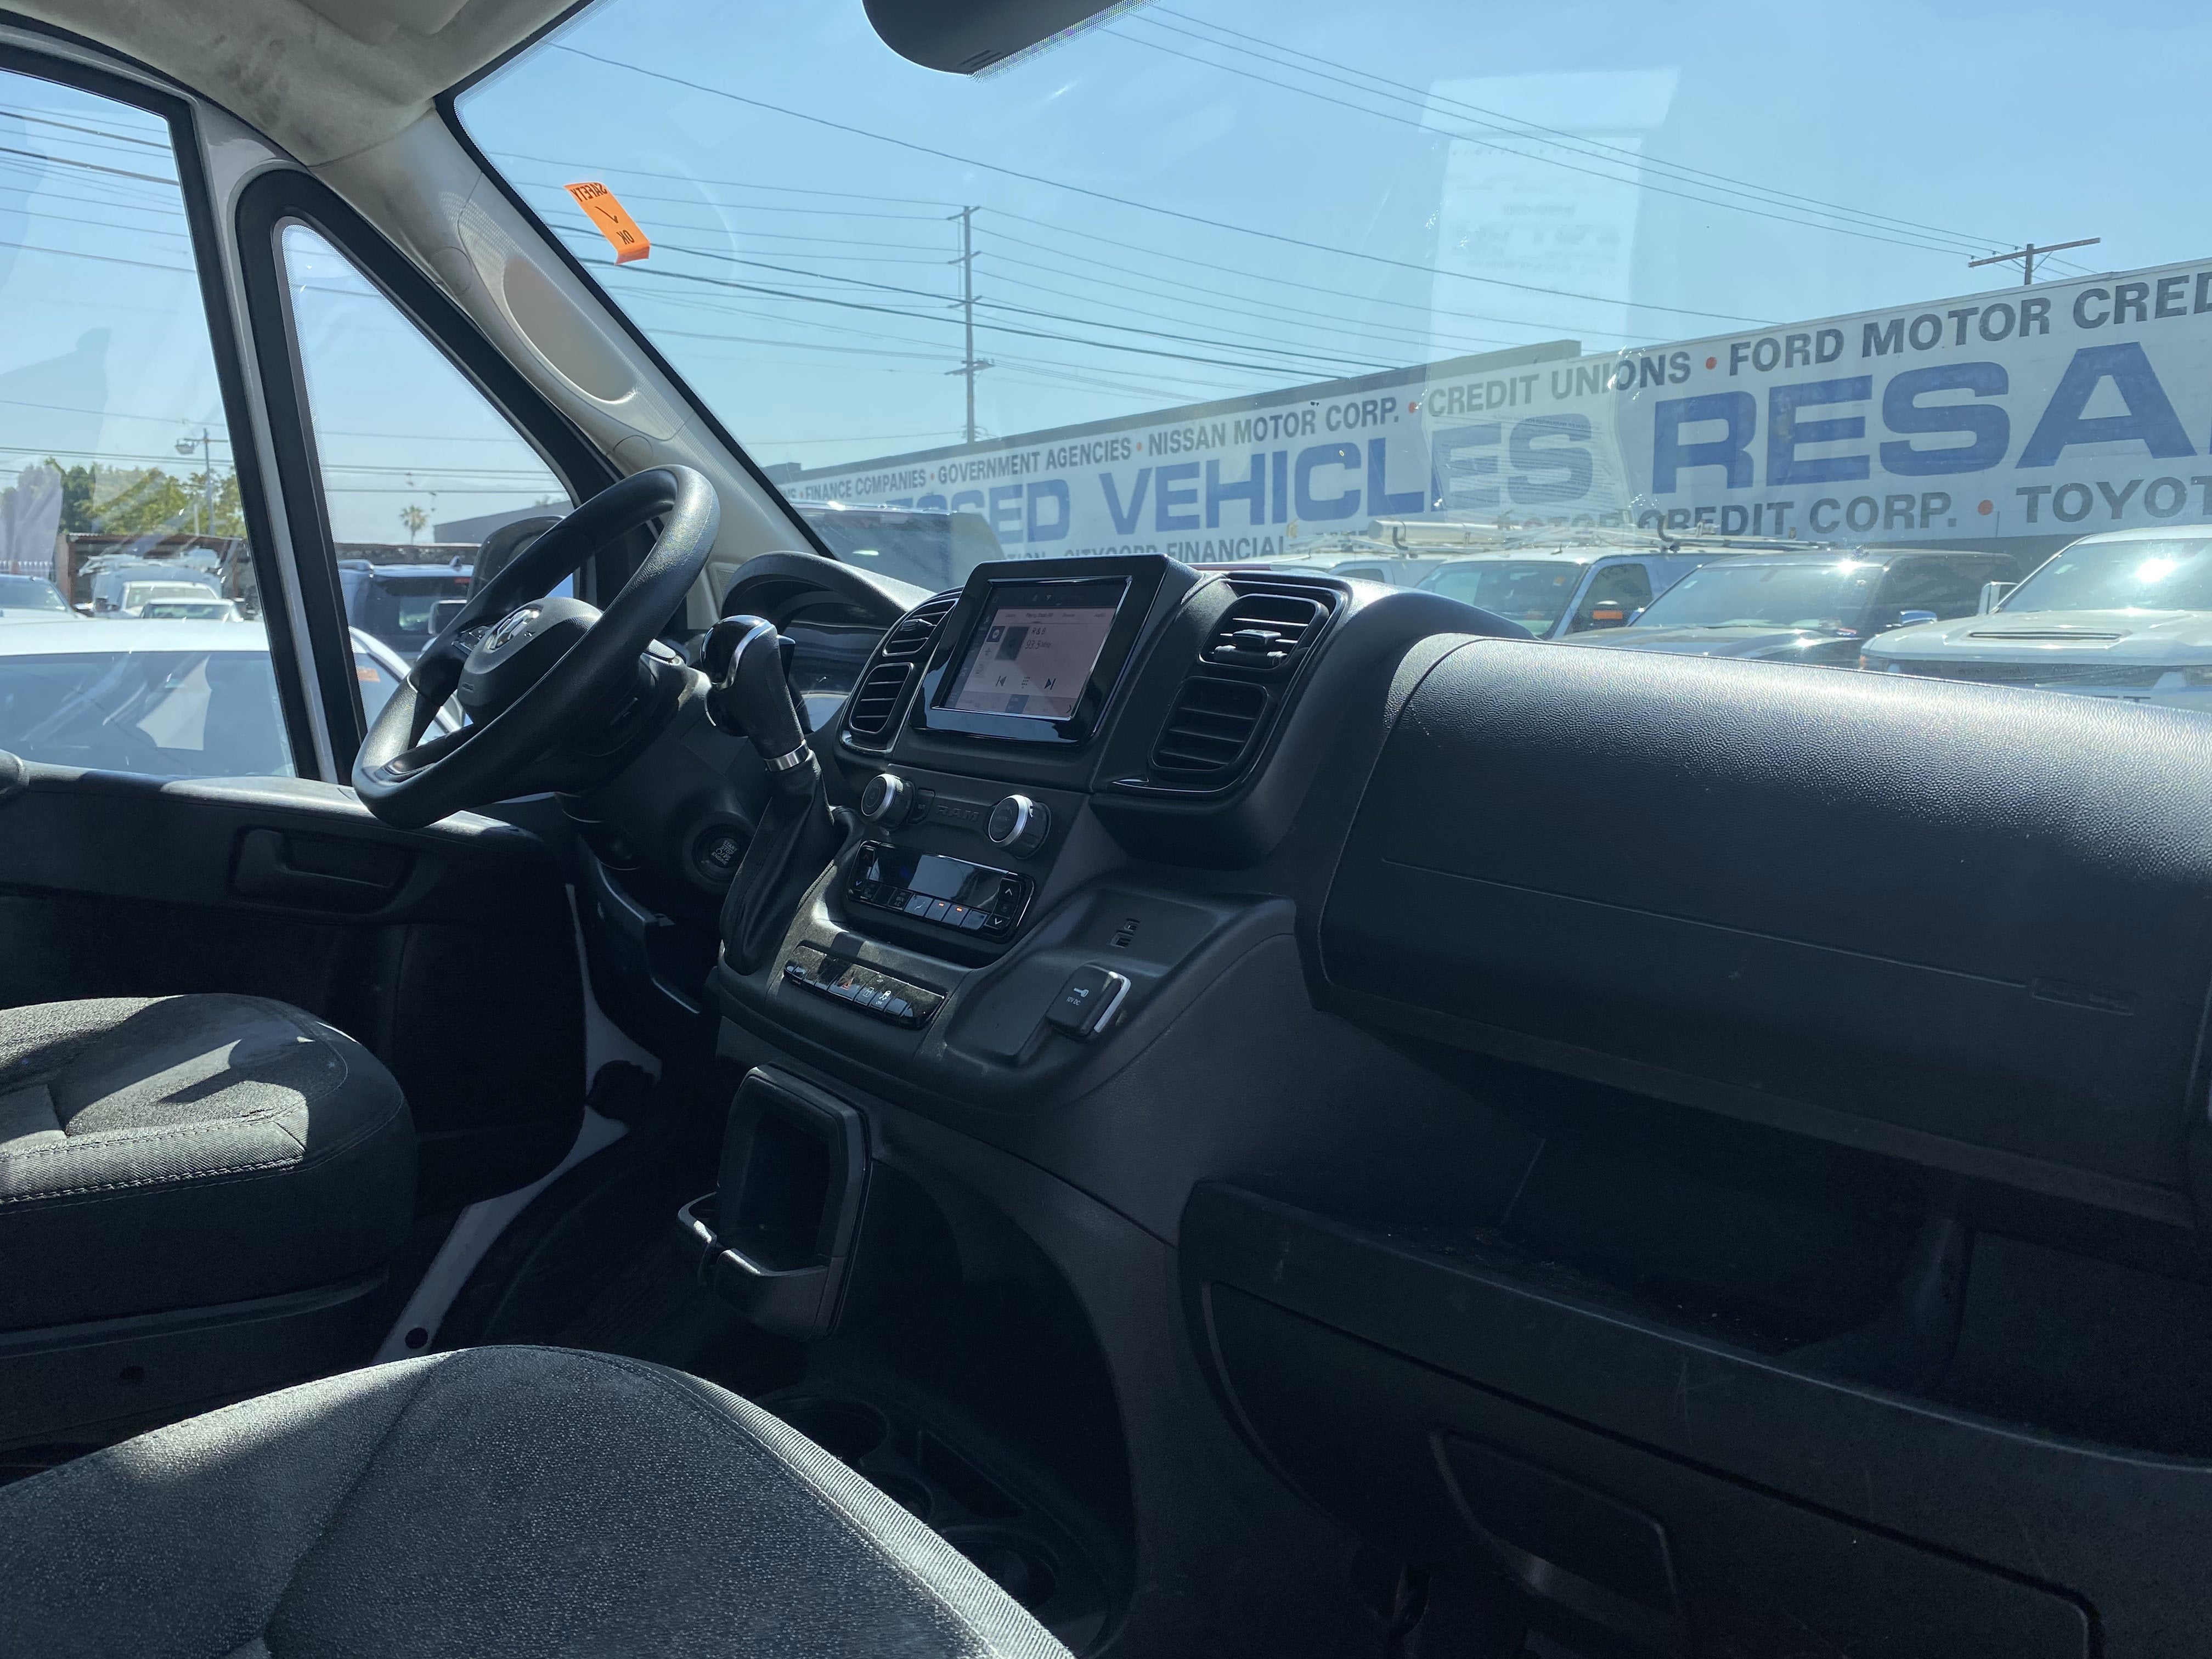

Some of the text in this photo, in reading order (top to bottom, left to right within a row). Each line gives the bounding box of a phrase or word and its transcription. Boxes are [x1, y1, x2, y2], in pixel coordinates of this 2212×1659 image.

[805, 480, 852, 500] FINANCE
[855, 470, 926, 495] COMPANIES
[938, 452, 1040, 484] GOVERNMENT
[1045, 438, 1132, 470] AGENCIES
[1148, 422, 1226, 456] NISSAN
[1233, 409, 1316, 445] MOTOR
[1325, 397, 1399, 432] CORP.
[1427, 374, 1539, 417] CREDIT
[1551, 351, 1691, 400] UNIONS
[1729, 329, 1844, 376] FORD
[1862, 297, 2051, 358] MOTOR
[1099, 413, 1593, 536] VEHICLES
[1652, 342, 2212, 494] RESA
[1810, 492, 1957, 534] CORP.
[934, 804, 980, 822] RAM
[720, 845, 734, 855] STOP
[723, 840, 738, 852] START
[712, 851, 728, 866] ENGINE
